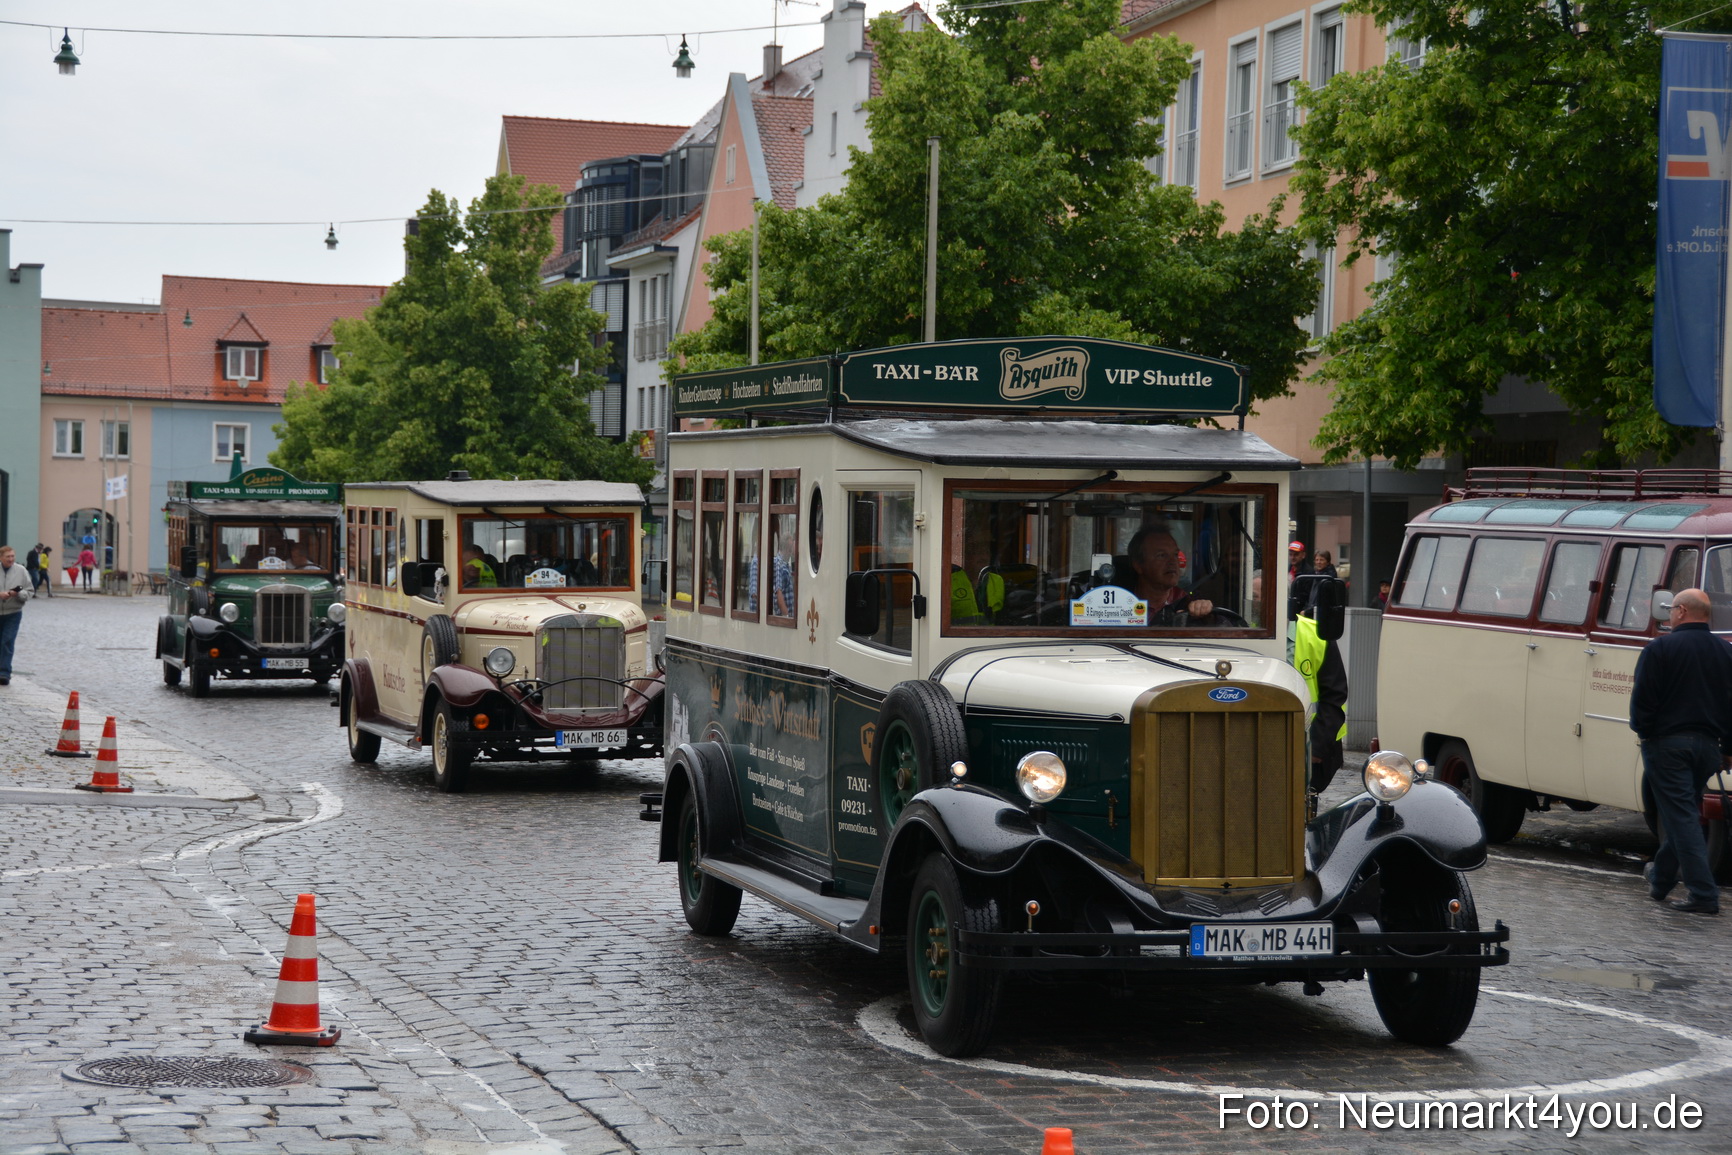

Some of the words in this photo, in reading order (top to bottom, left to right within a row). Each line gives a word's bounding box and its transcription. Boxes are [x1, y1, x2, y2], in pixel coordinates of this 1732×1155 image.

[1009, 356, 1078, 390] Asquith
[1105, 368, 1140, 386] VIP
[1143, 369, 1212, 388] Shuttle
[732, 380, 761, 400] Hochzeiten
[243, 472, 284, 486] Casino
[541, 570, 550, 579] 94
[1103, 590, 1115, 604] 31
[383, 663, 406, 694] Kutsche
[1589, 681, 1632, 694] VERKEHRSBETR
[1215, 689, 1240, 700] Ford
[563, 732, 584, 744] MAK
[591, 731, 605, 743] MB
[607, 731, 620, 743] 66
[846, 775, 867, 793] TAXI
[841, 798, 867, 816] 09231
[1205, 928, 1246, 952] MAK
[1261, 928, 1288, 951] MB
[1293, 926, 1332, 951] 44H
